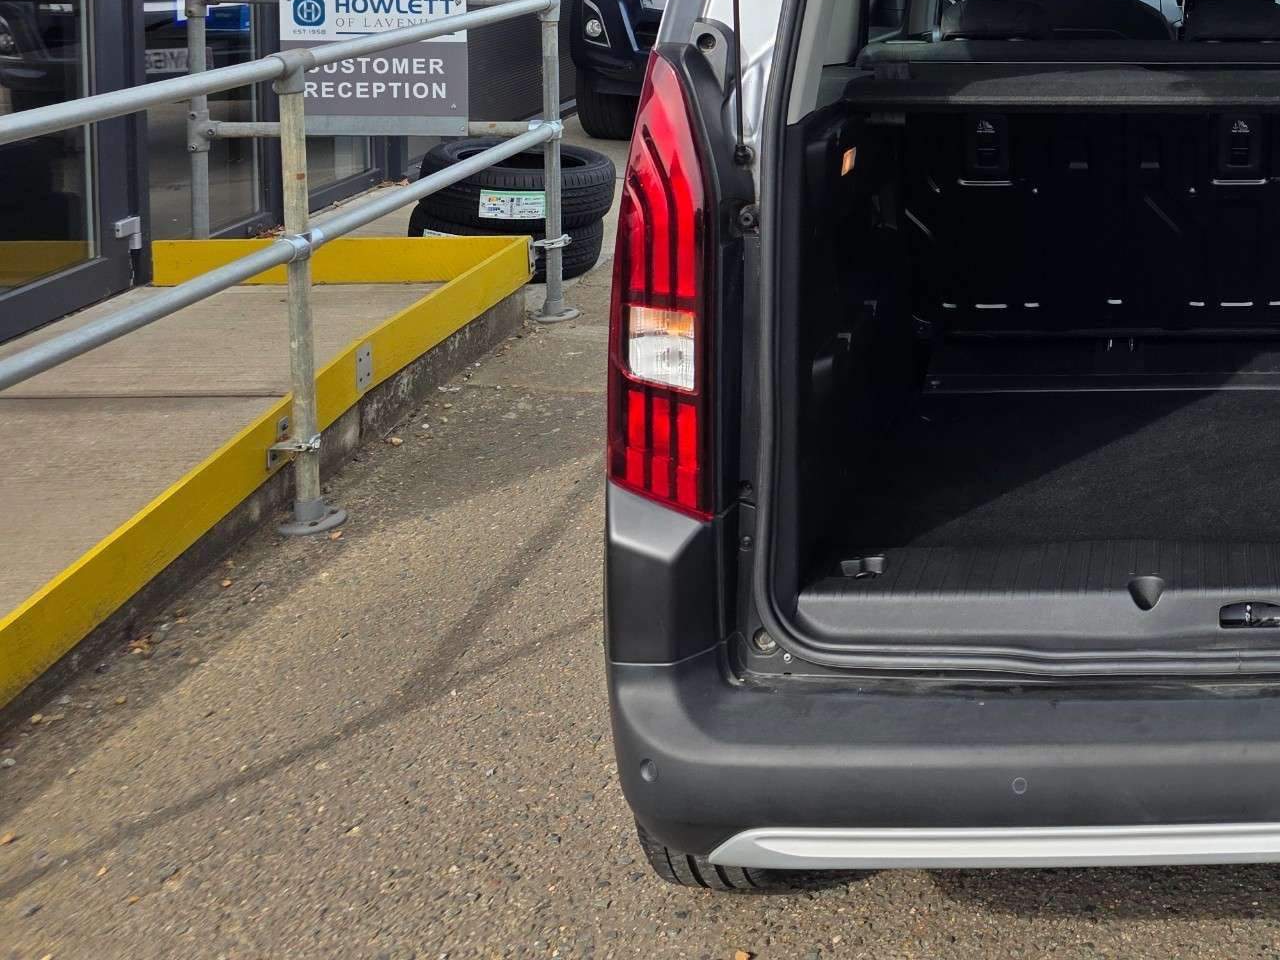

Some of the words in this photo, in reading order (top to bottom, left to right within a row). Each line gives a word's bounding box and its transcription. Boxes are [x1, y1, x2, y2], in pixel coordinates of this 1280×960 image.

[335, 17, 355, 28] OF
[308, 58, 445, 74] USTOMER
[303, 82, 447, 99] RECEPTION
